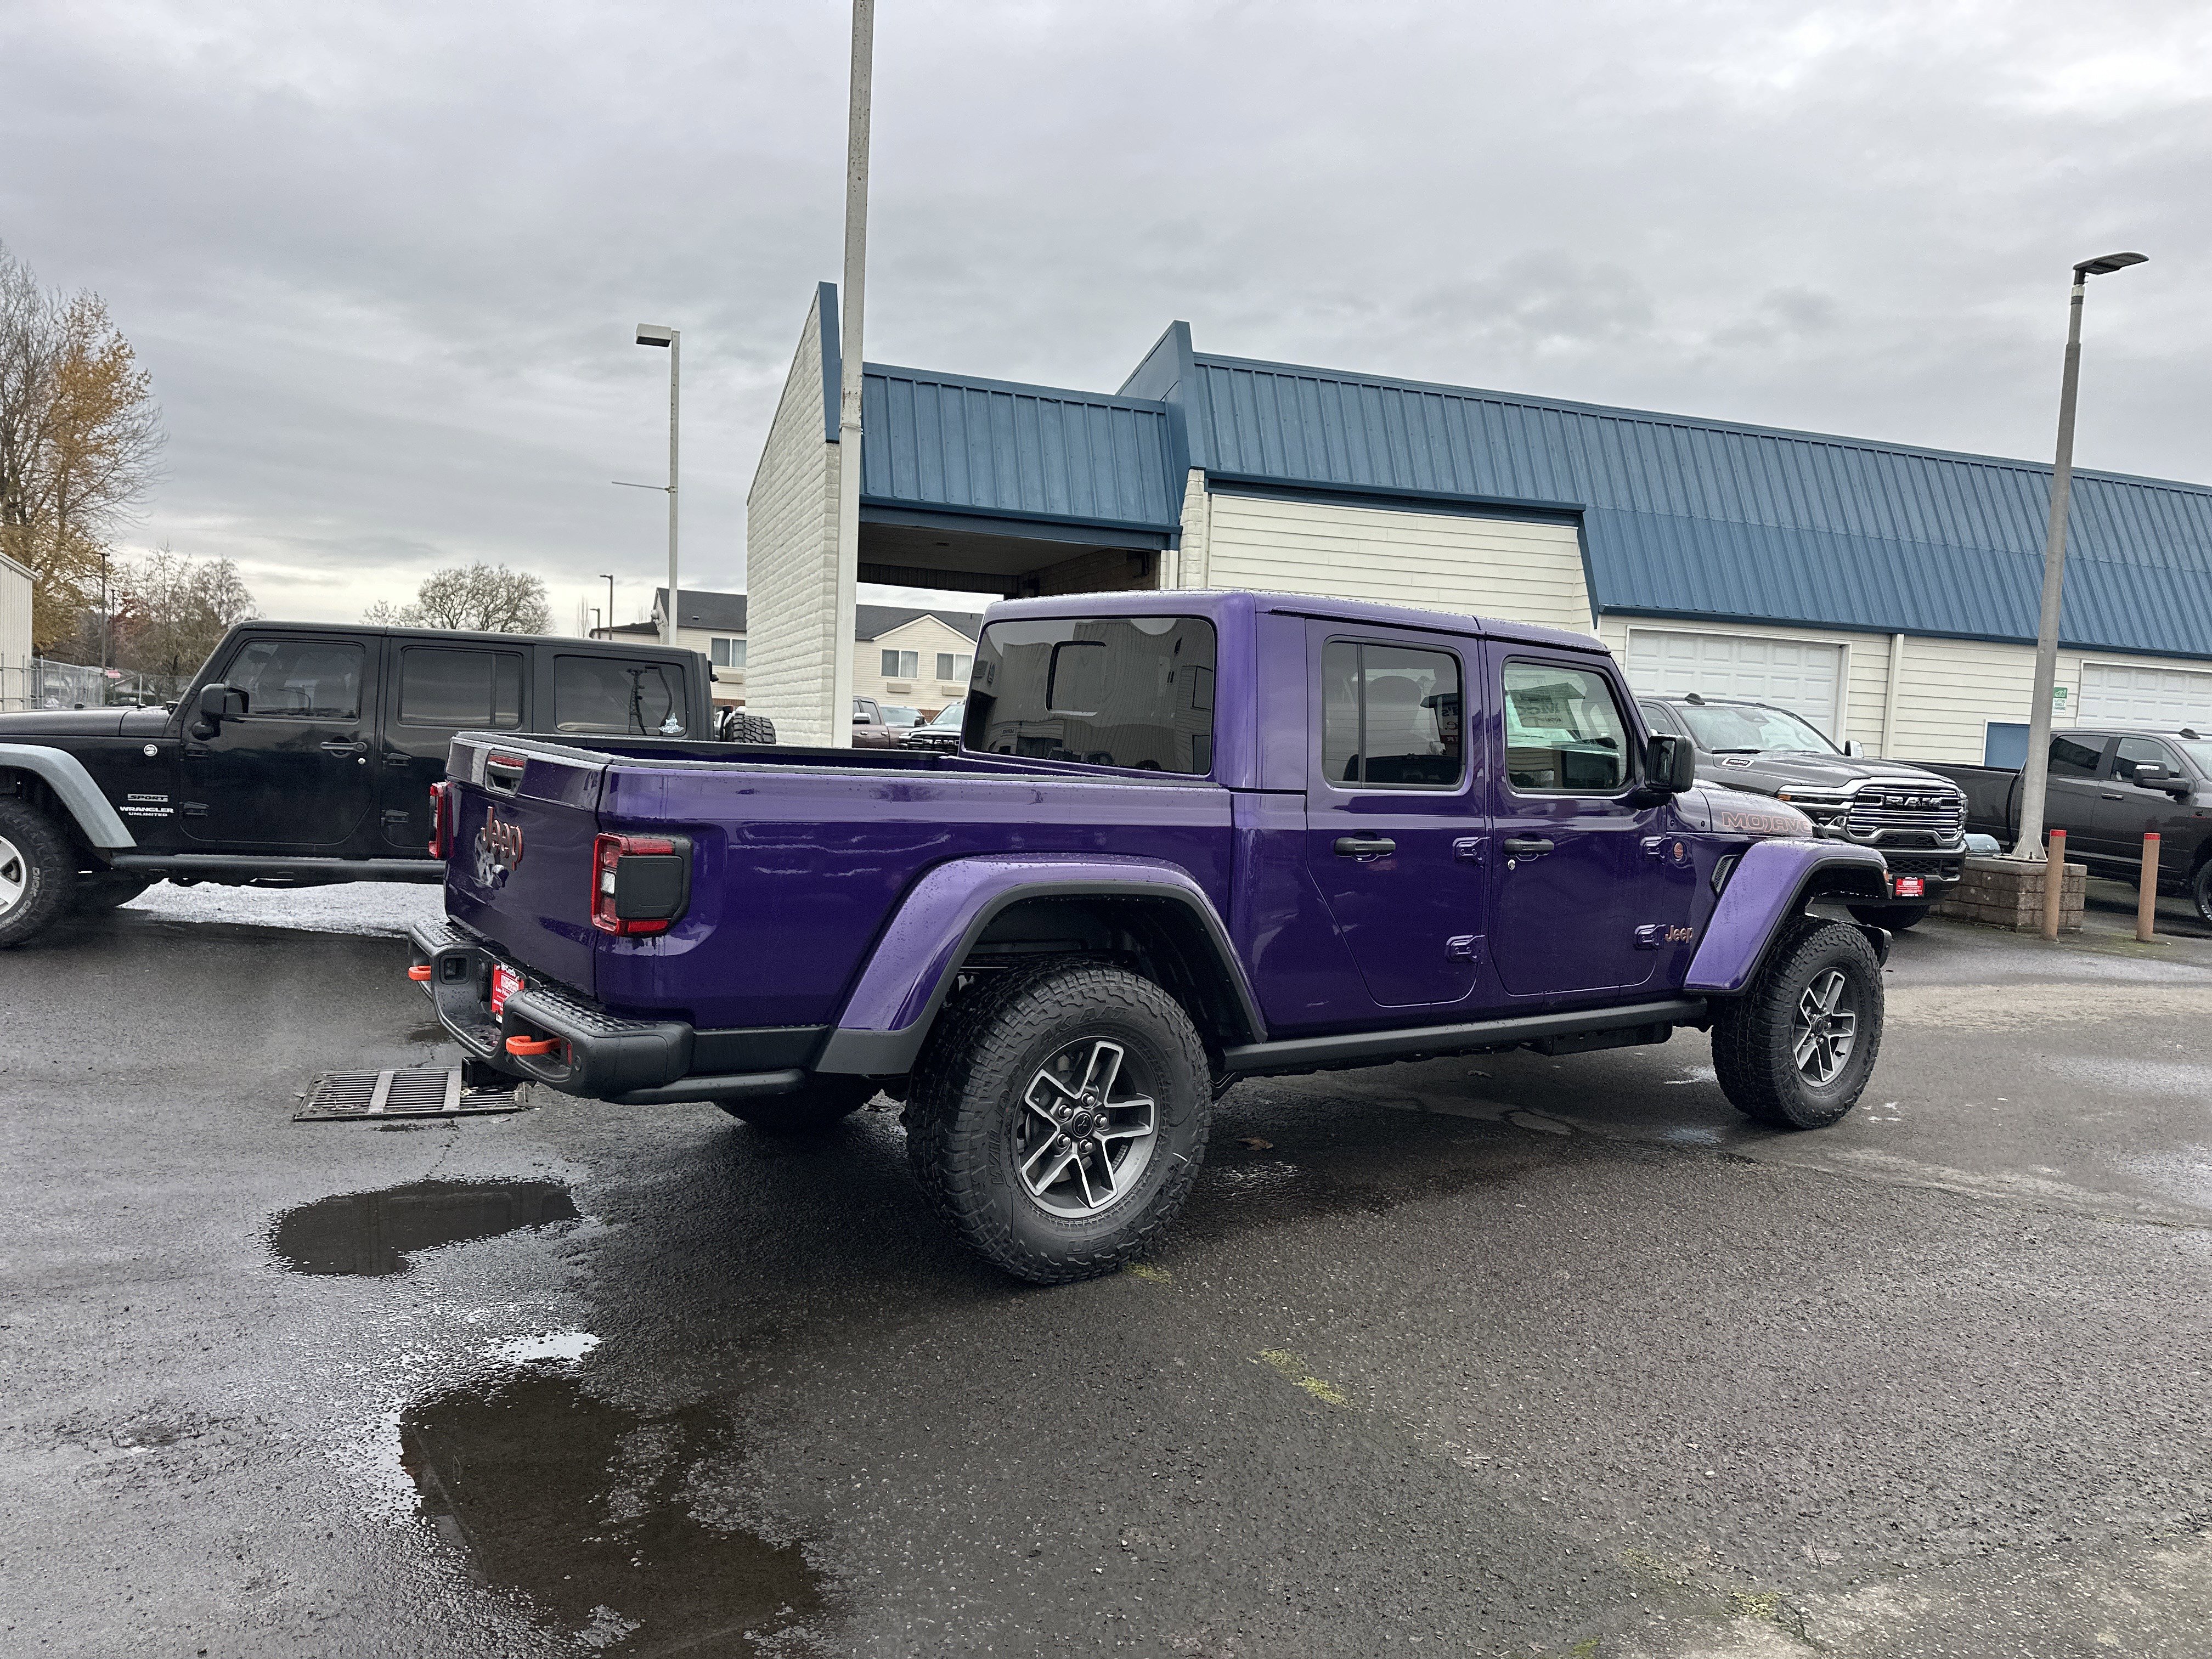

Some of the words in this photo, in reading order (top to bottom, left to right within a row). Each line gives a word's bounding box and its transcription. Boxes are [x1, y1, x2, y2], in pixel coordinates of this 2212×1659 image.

[1886, 796, 1940, 806] RAM
[1722, 811, 1812, 833] MOJAVE
[480, 806, 523, 871] Jeep
[1664, 925, 1694, 944] Jeep
